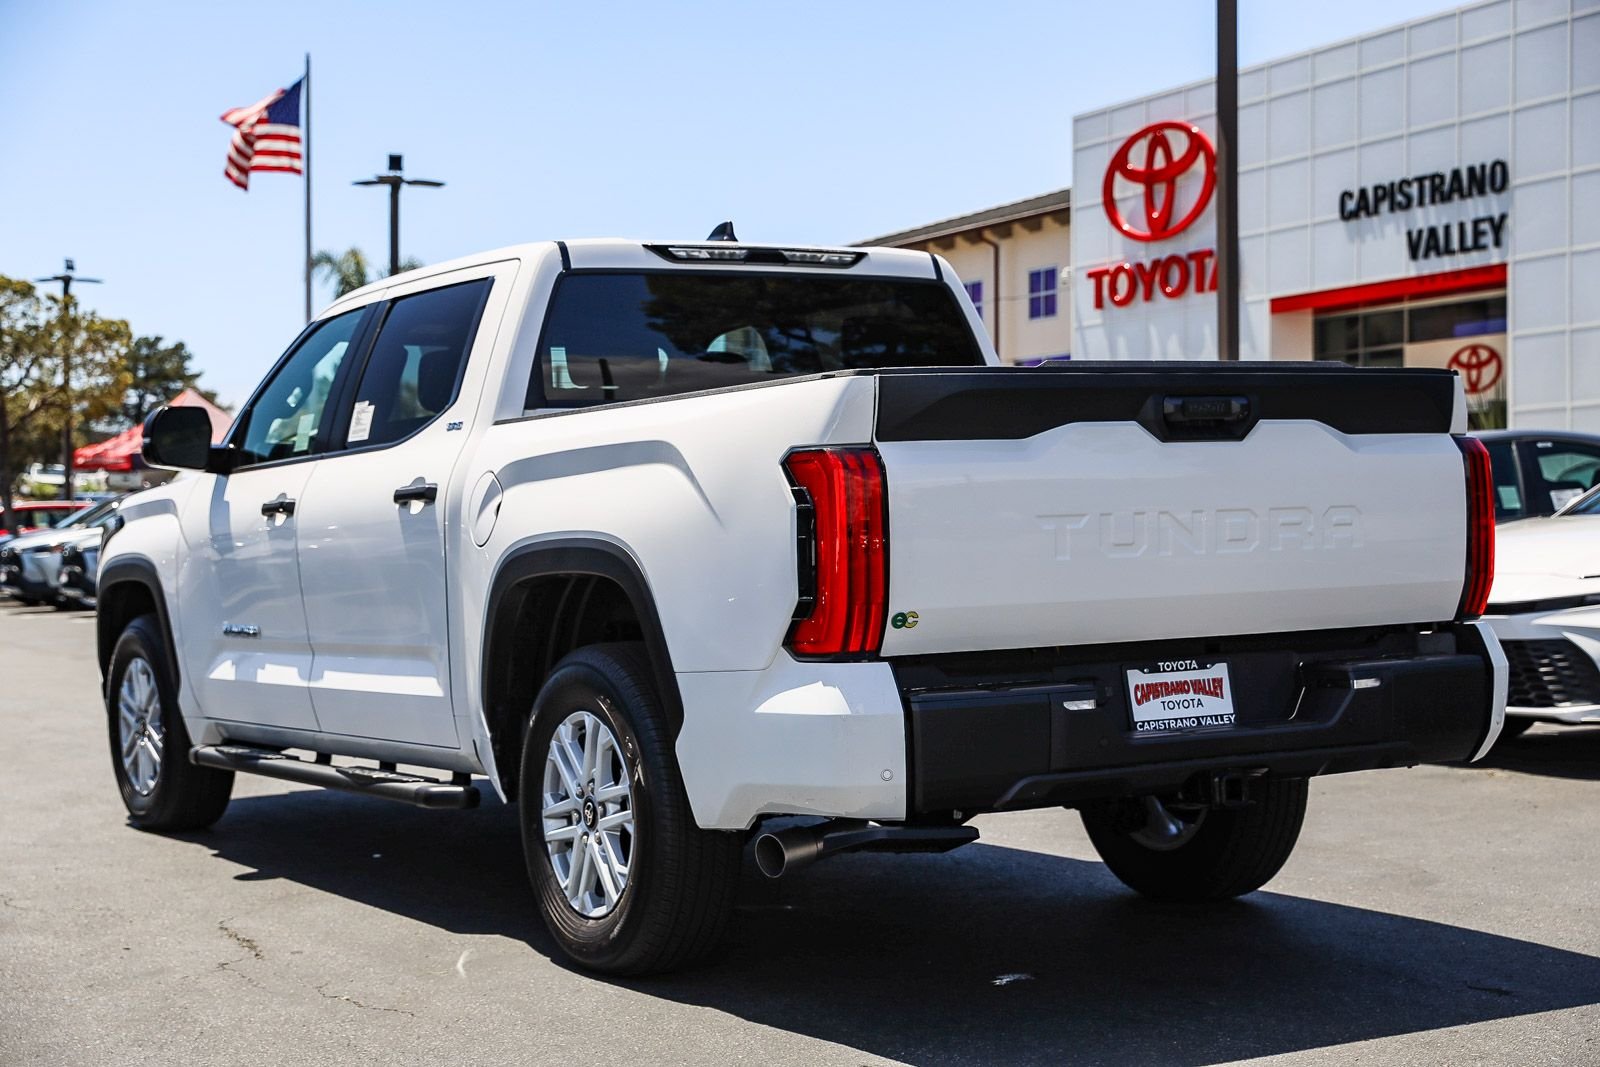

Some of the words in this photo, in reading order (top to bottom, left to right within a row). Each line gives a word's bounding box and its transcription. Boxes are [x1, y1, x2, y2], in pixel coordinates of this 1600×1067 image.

[1339, 159, 1508, 222] CAPISTRANO
[1406, 213, 1507, 261] VALLEY
[1035, 505, 1364, 561] TUNDRA
[1158, 660, 1198, 671] TOYOTA
[1134, 680, 1190, 706] CAPISTRANO
[1190, 677, 1224, 699] VALLEY
[1160, 698, 1204, 711] TOYOTA
[1137, 719, 1197, 731] CAPISTRANO
[1200, 714, 1236, 724] VALLEY
